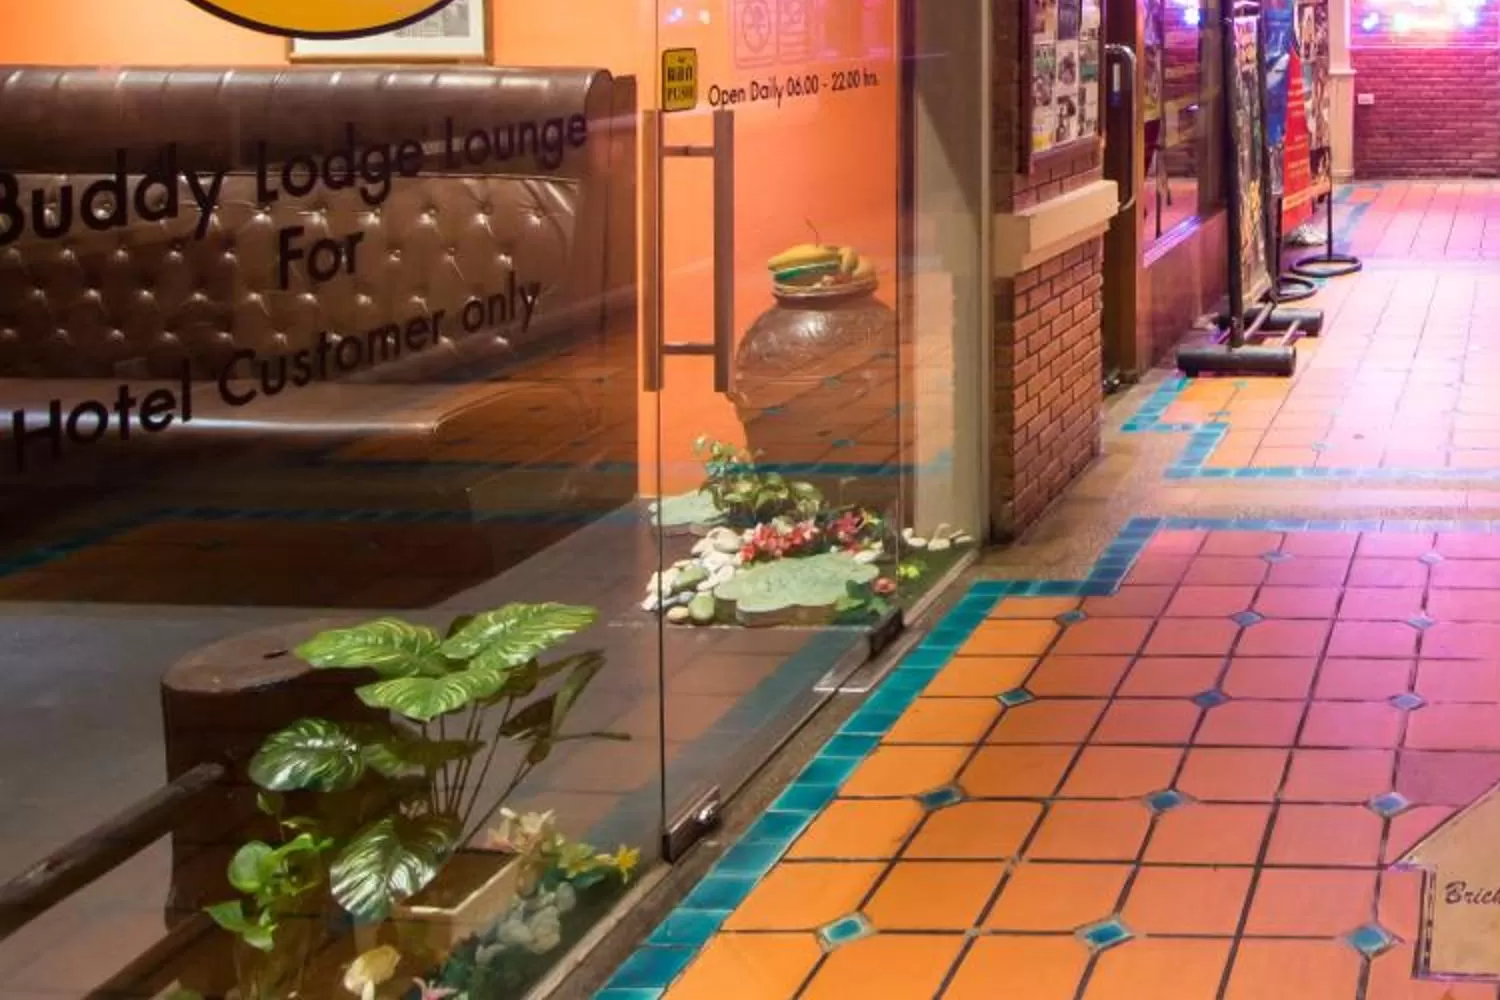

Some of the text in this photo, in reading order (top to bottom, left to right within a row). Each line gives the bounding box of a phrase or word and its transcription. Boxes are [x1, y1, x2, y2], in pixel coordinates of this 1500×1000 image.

[708, 84, 746, 110] Open
[751, 76, 784, 109] Daily
[0, 113, 588, 245] Buddy Lodge Lounge
[278, 226, 364, 290] For
[12, 271, 541, 472] Hotel Customer only
